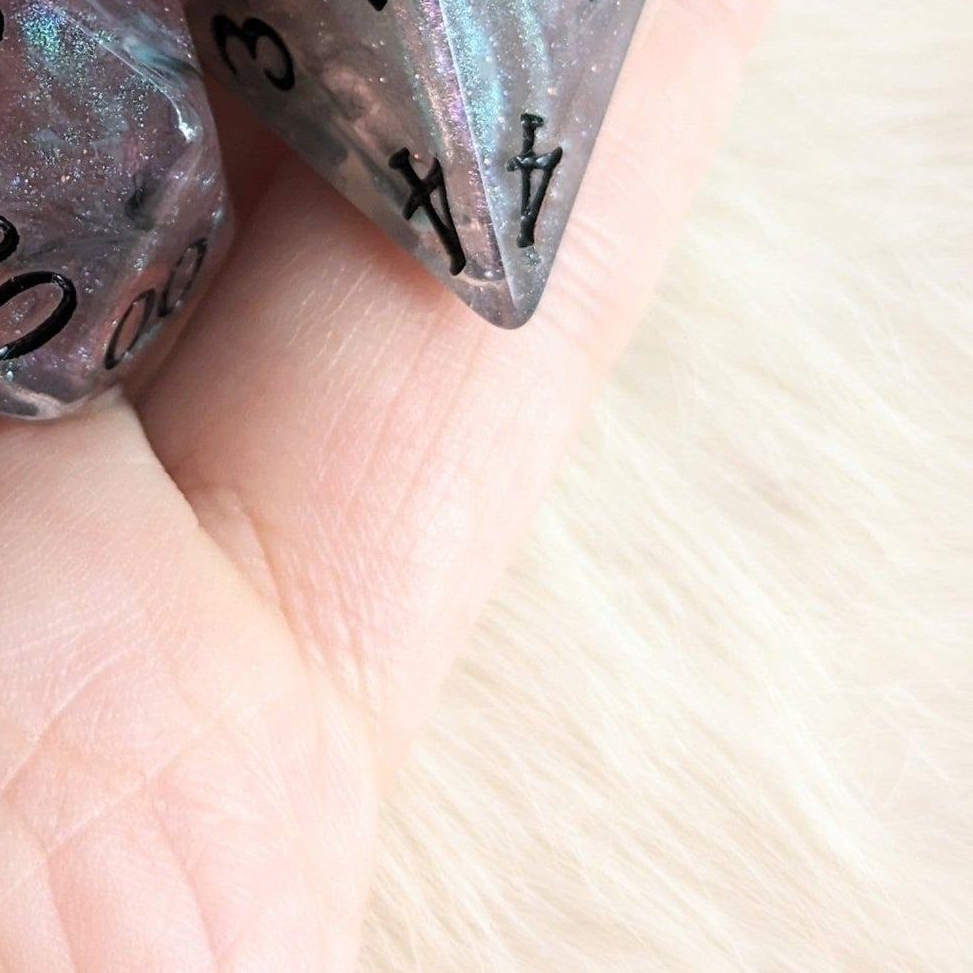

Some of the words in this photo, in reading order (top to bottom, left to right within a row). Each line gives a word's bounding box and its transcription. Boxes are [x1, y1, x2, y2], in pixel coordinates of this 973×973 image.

[212, 14, 296, 91] 3
[389, 147, 466, 276] 4
[507, 113, 563, 248] 4
